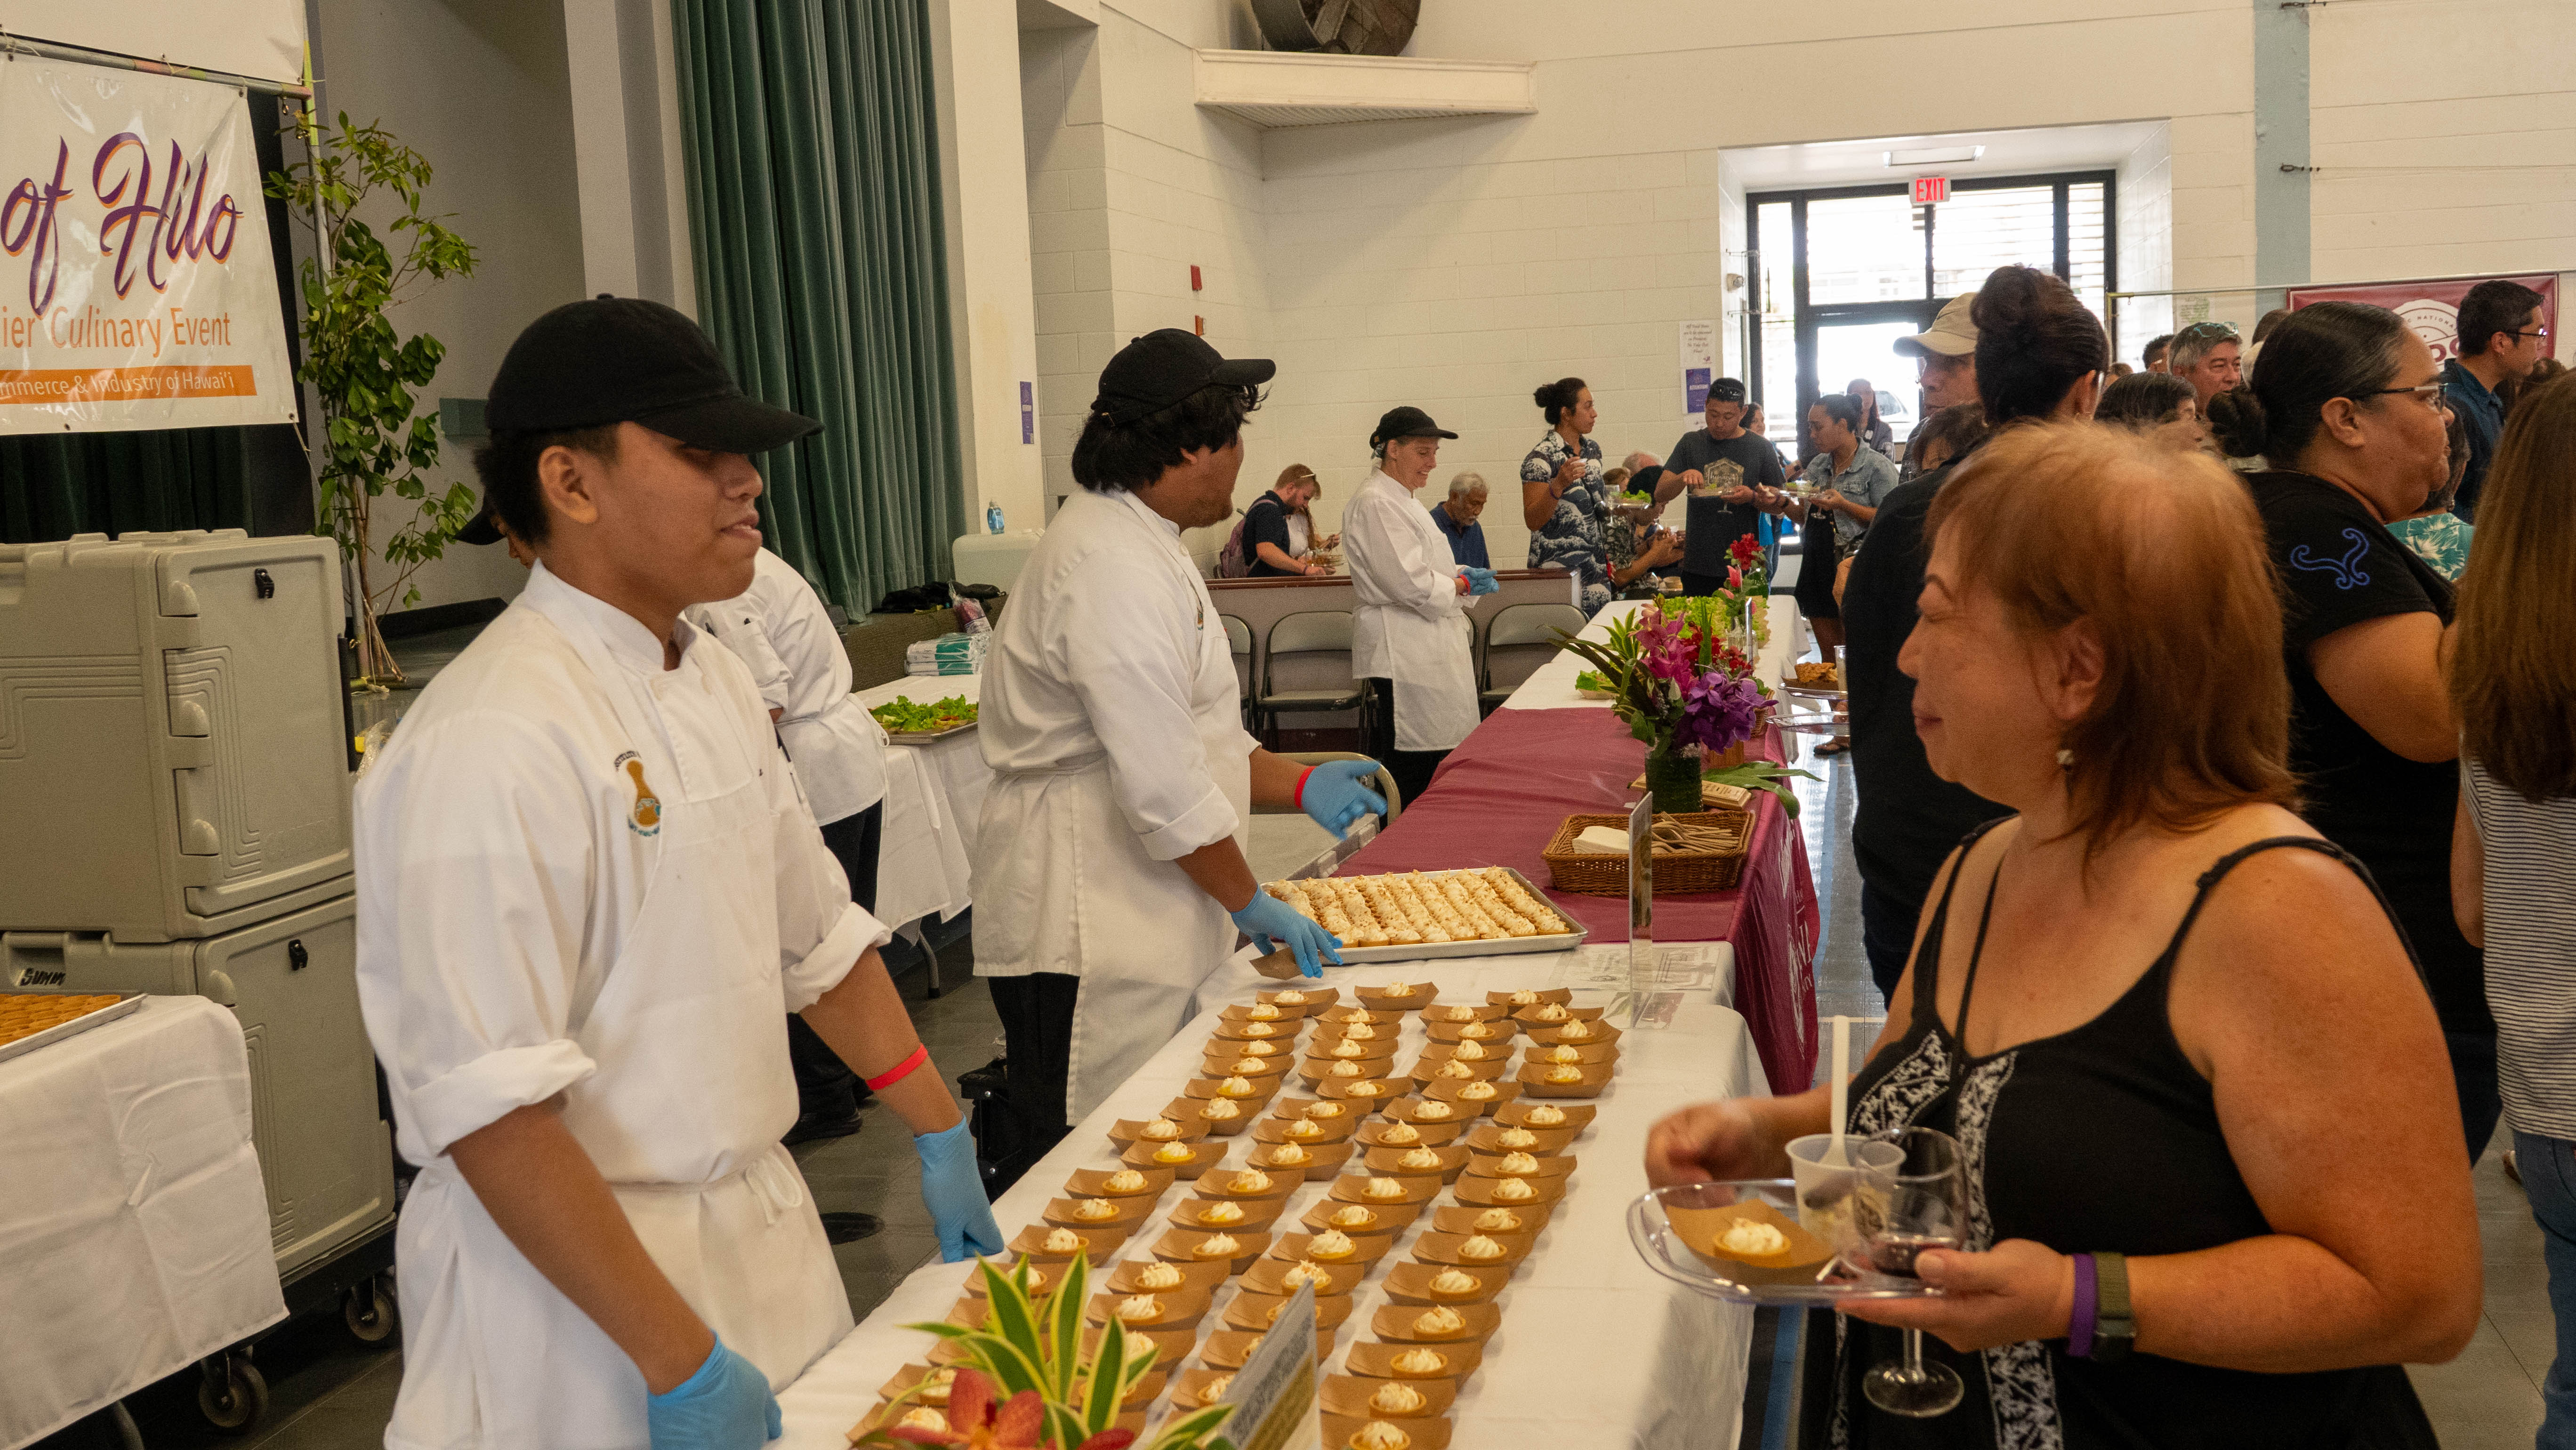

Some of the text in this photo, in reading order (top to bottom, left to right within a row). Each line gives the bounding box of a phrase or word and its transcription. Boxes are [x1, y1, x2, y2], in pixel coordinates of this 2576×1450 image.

[1916, 177, 1946, 202] EXIT
[0, 132, 244, 320] of Hilo
[3, 305, 231, 358] ier Culinary Event
[0, 381, 69, 395] mmerce
[74, 375, 89, 394] &
[90, 371, 162, 396] Industry
[166, 371, 178, 390] of
